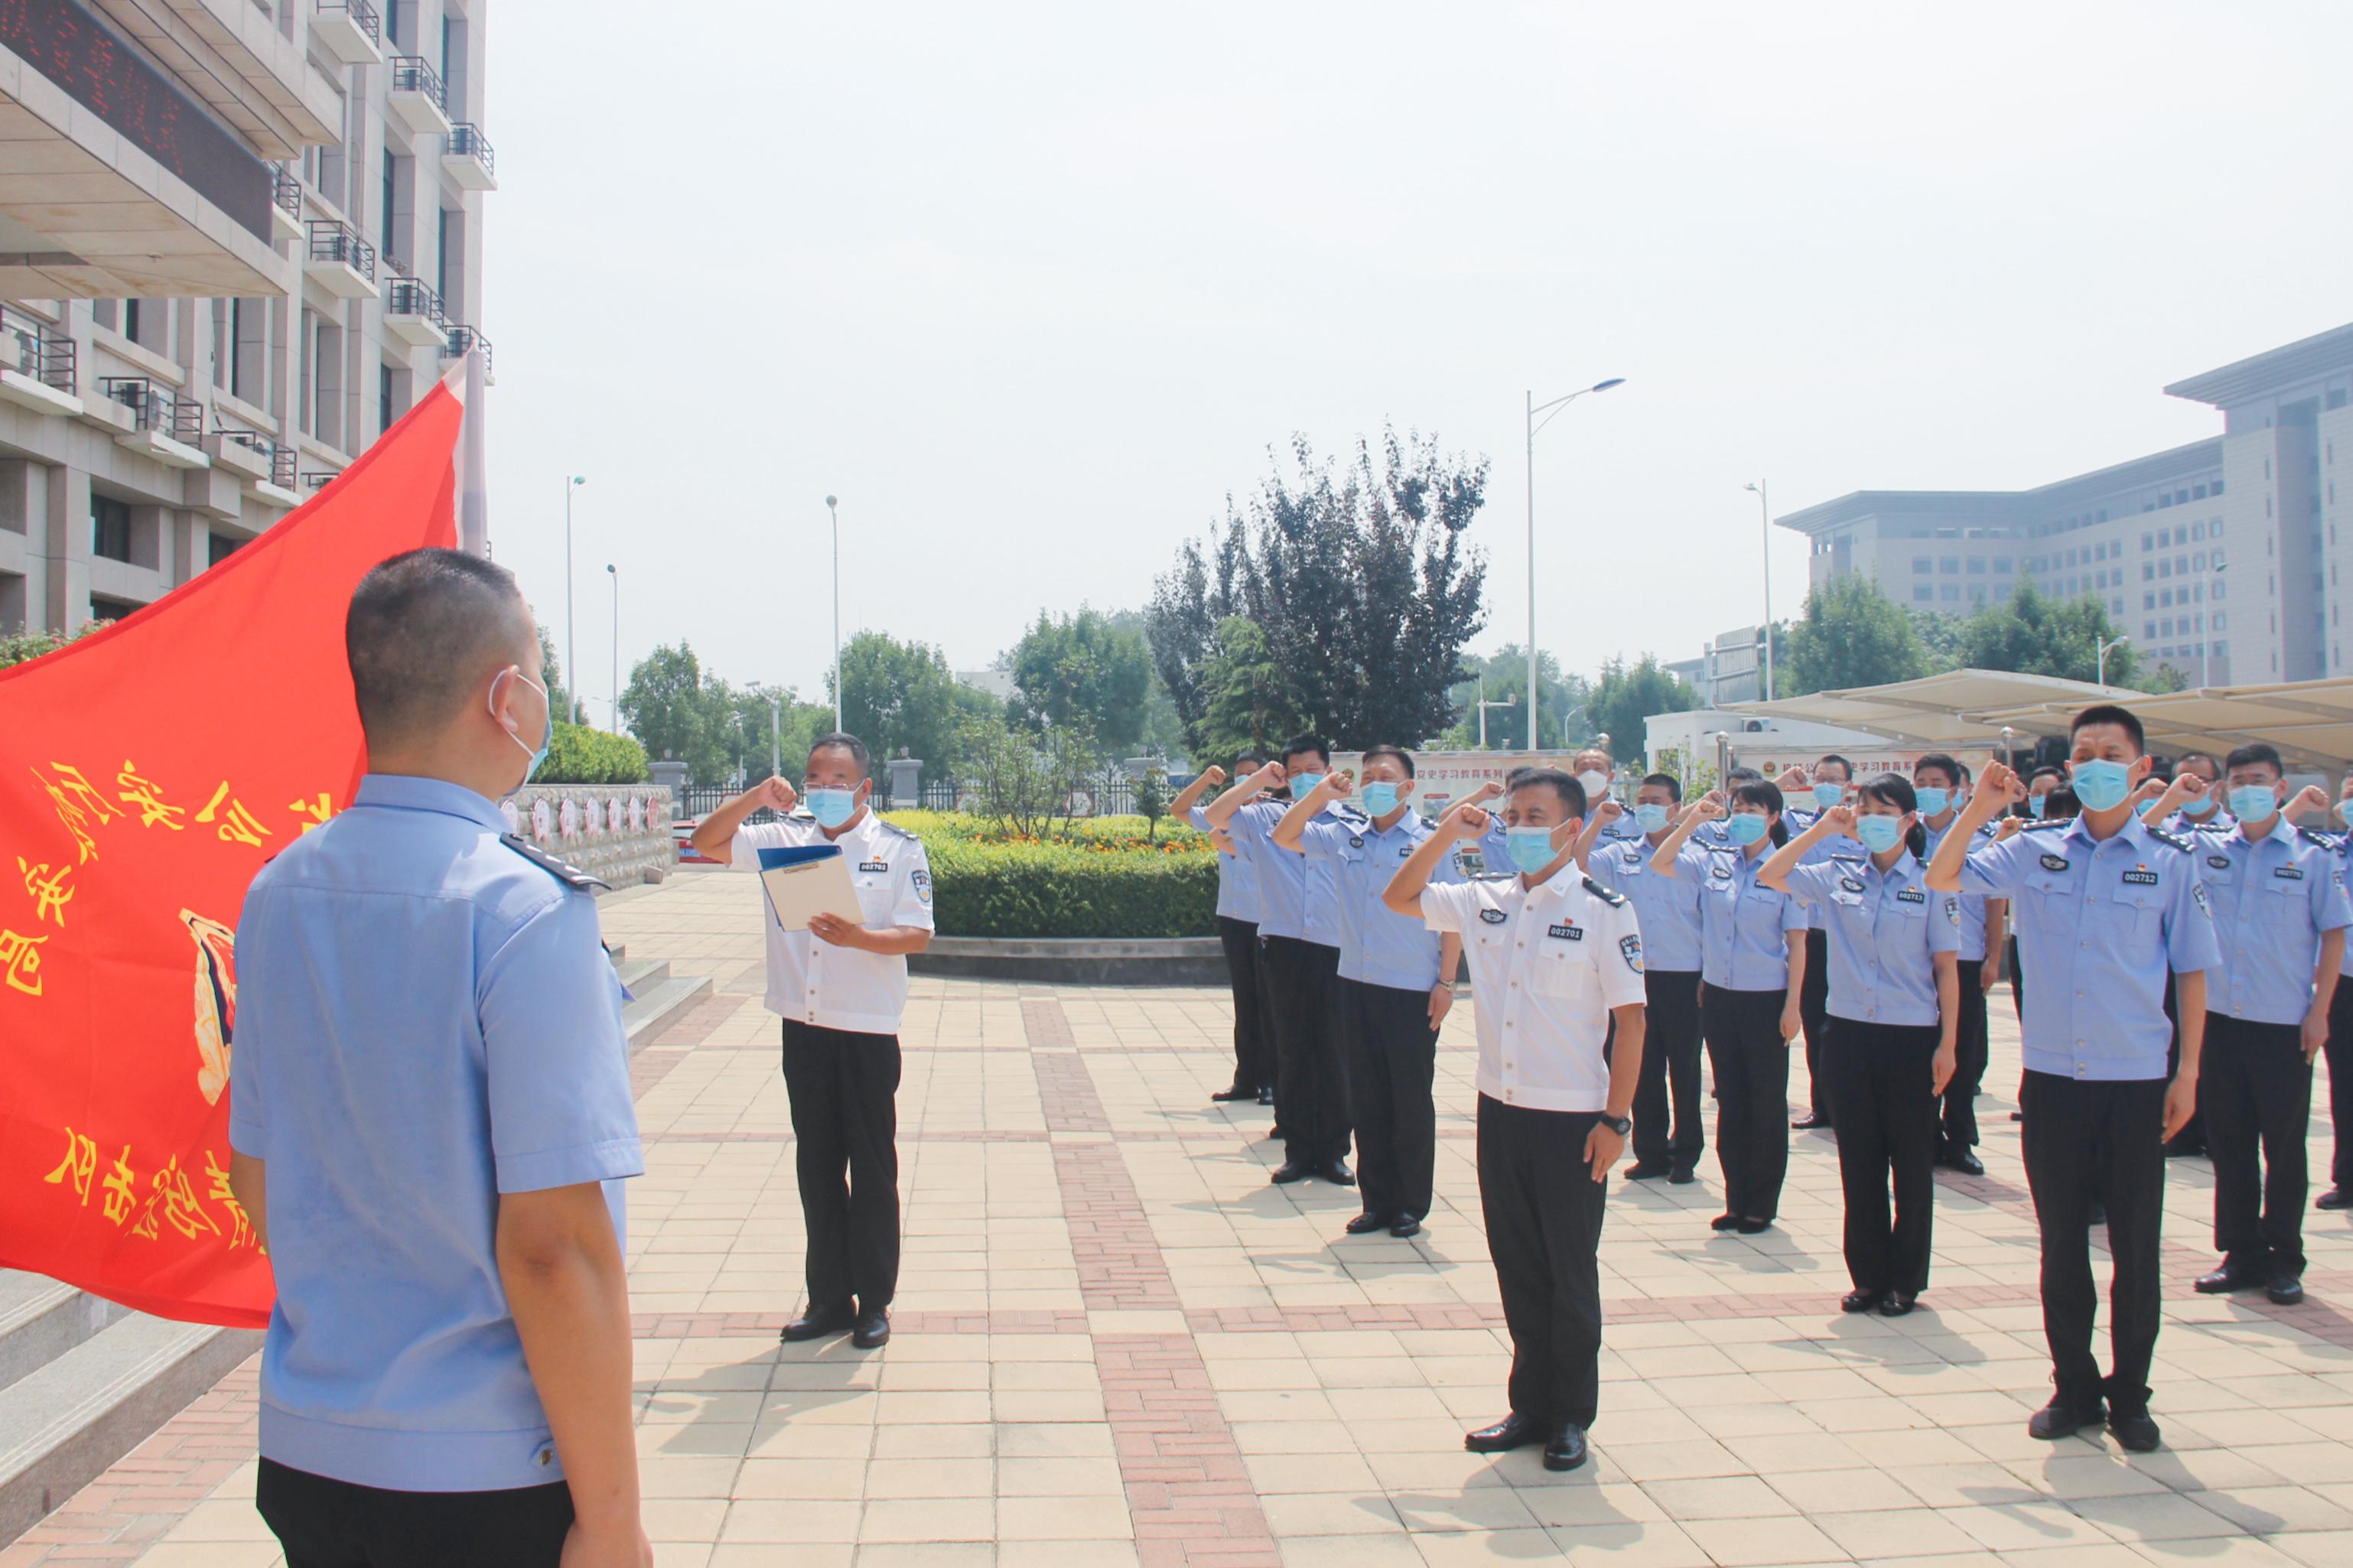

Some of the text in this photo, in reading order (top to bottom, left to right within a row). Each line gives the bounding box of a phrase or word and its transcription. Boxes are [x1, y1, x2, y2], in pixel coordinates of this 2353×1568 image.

[2124, 873, 2156, 883] 002712
[1899, 892, 1923, 901] 002713
[1550, 926, 1580, 938] 002701
